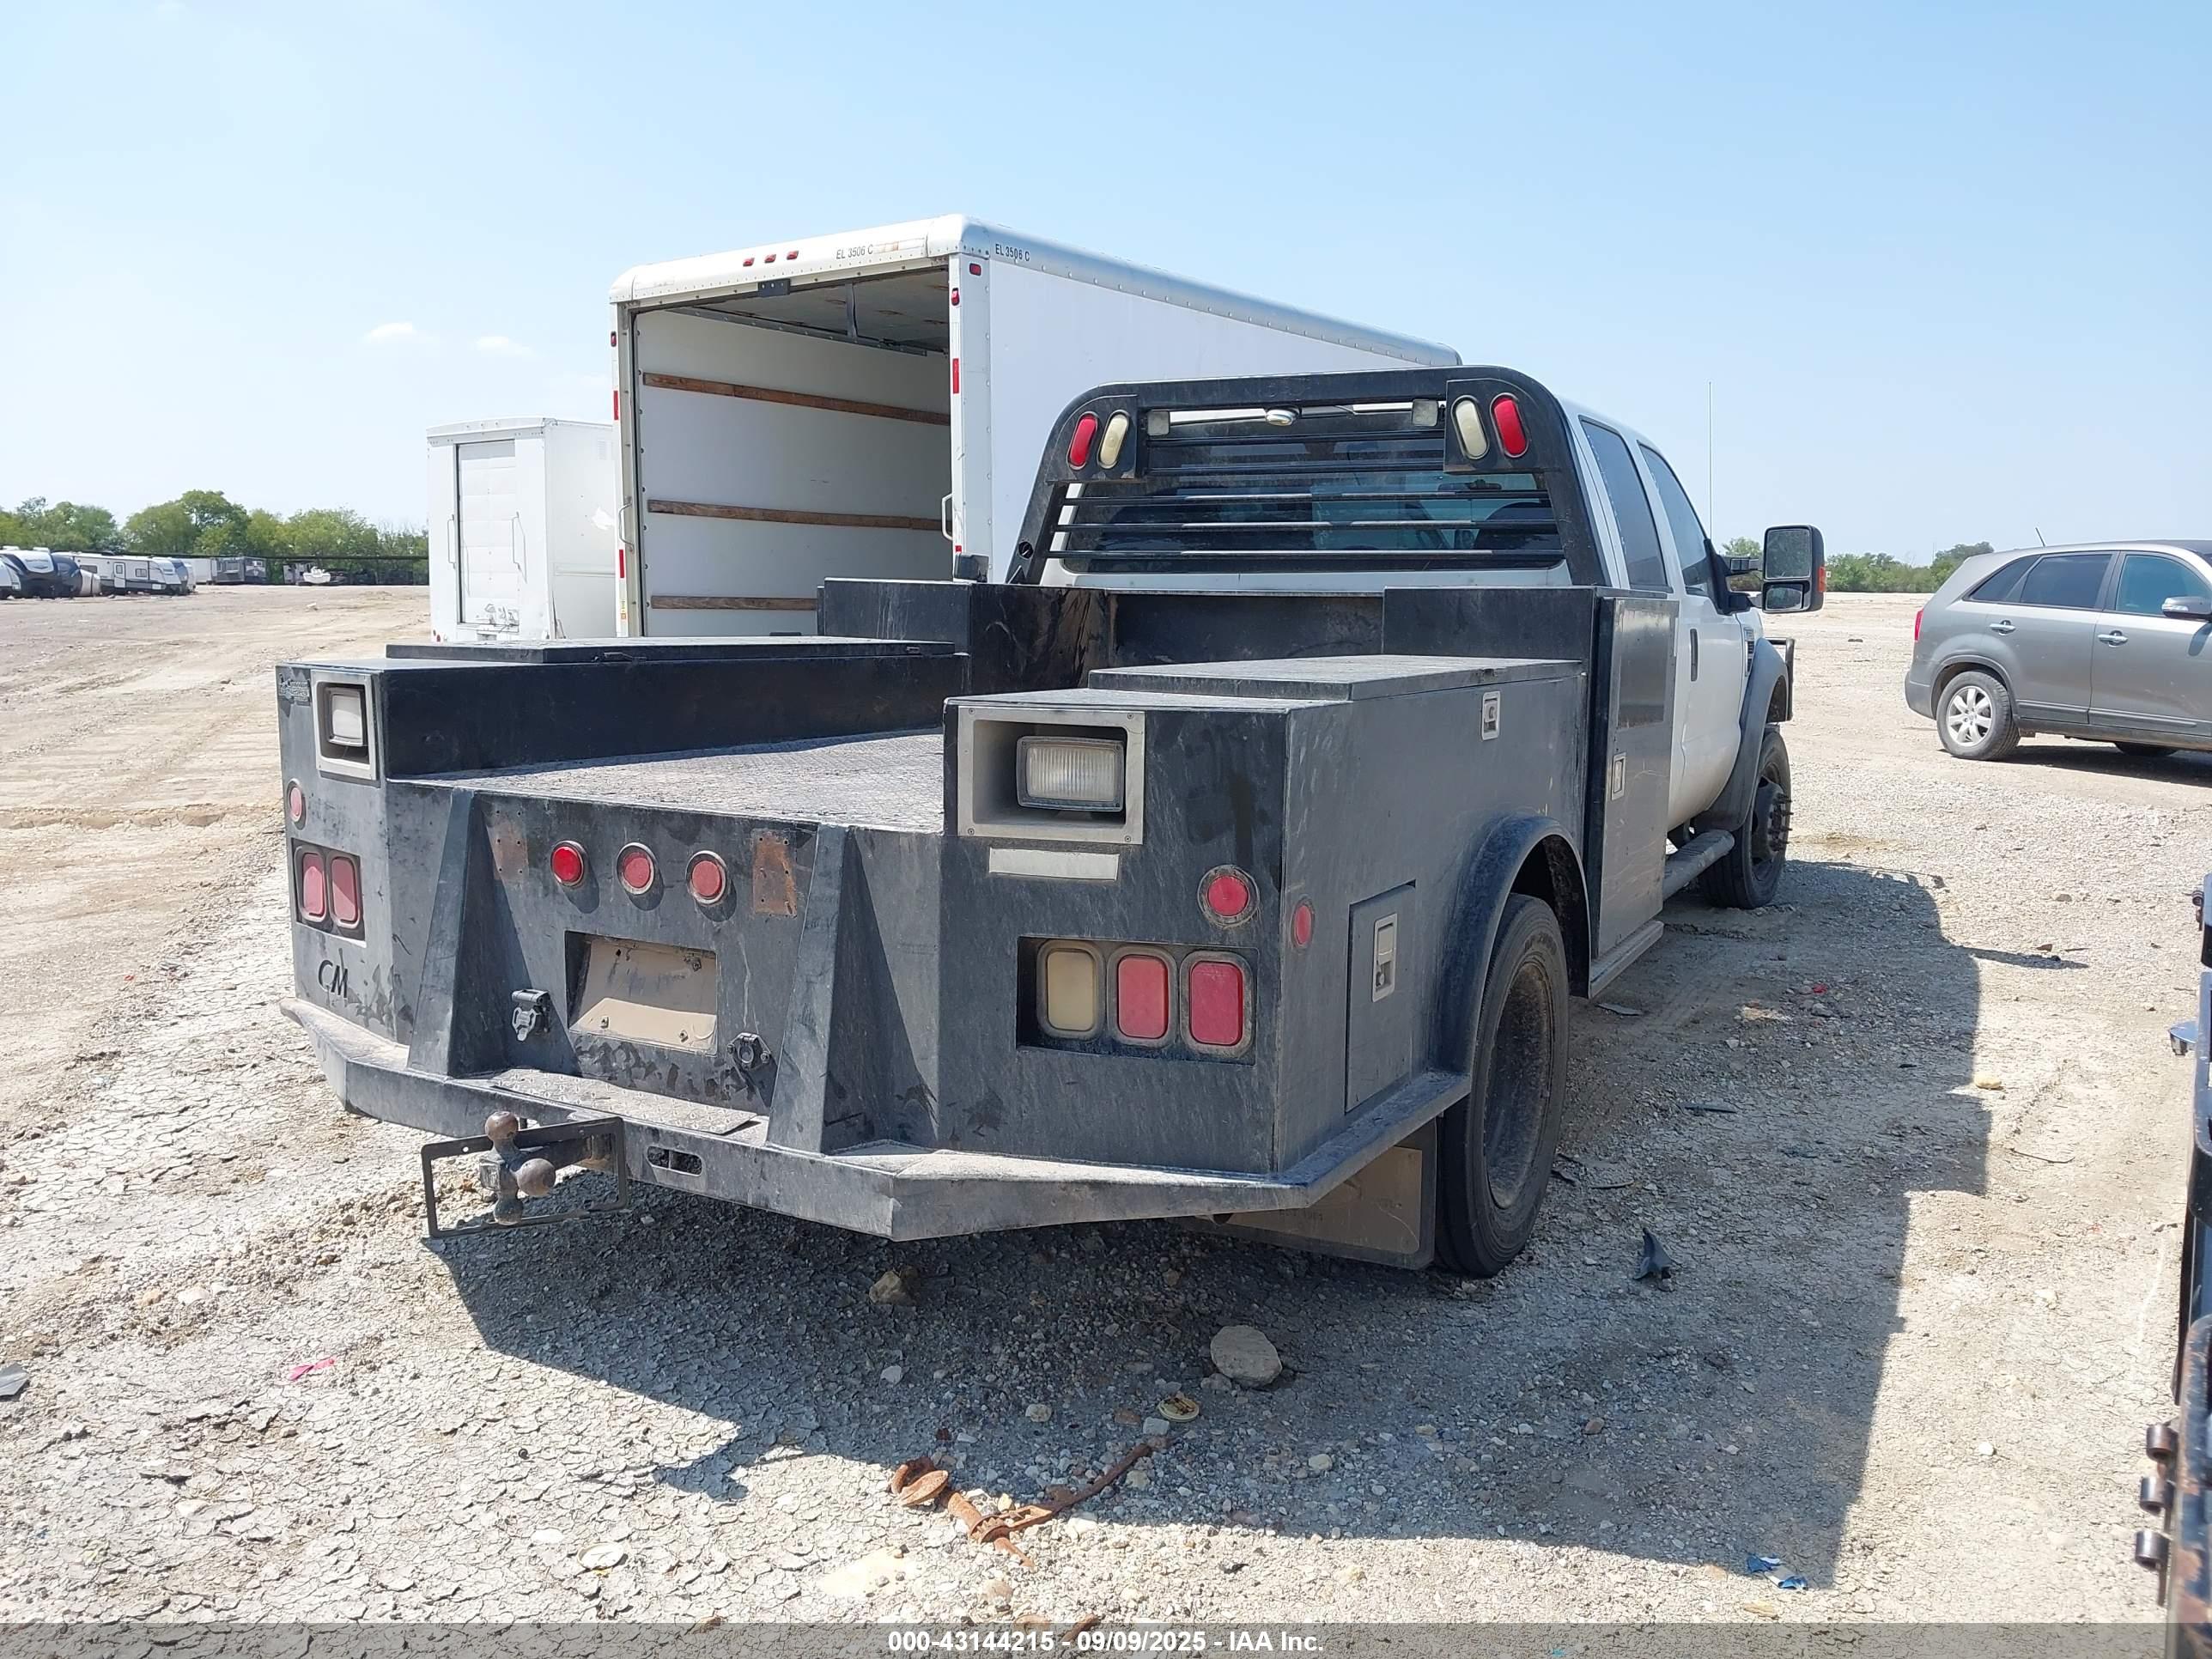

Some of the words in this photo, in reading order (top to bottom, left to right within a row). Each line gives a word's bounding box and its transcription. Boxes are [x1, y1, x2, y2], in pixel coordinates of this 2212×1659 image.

[836, 249, 846, 259] EL
[848, 246, 866, 258] 3506
[867, 244, 873, 255] C
[995, 243, 1004, 256] EL
[1005, 246, 1023, 260] 3506
[1024, 251, 1030, 262] C
[318, 958, 349, 999] CM
